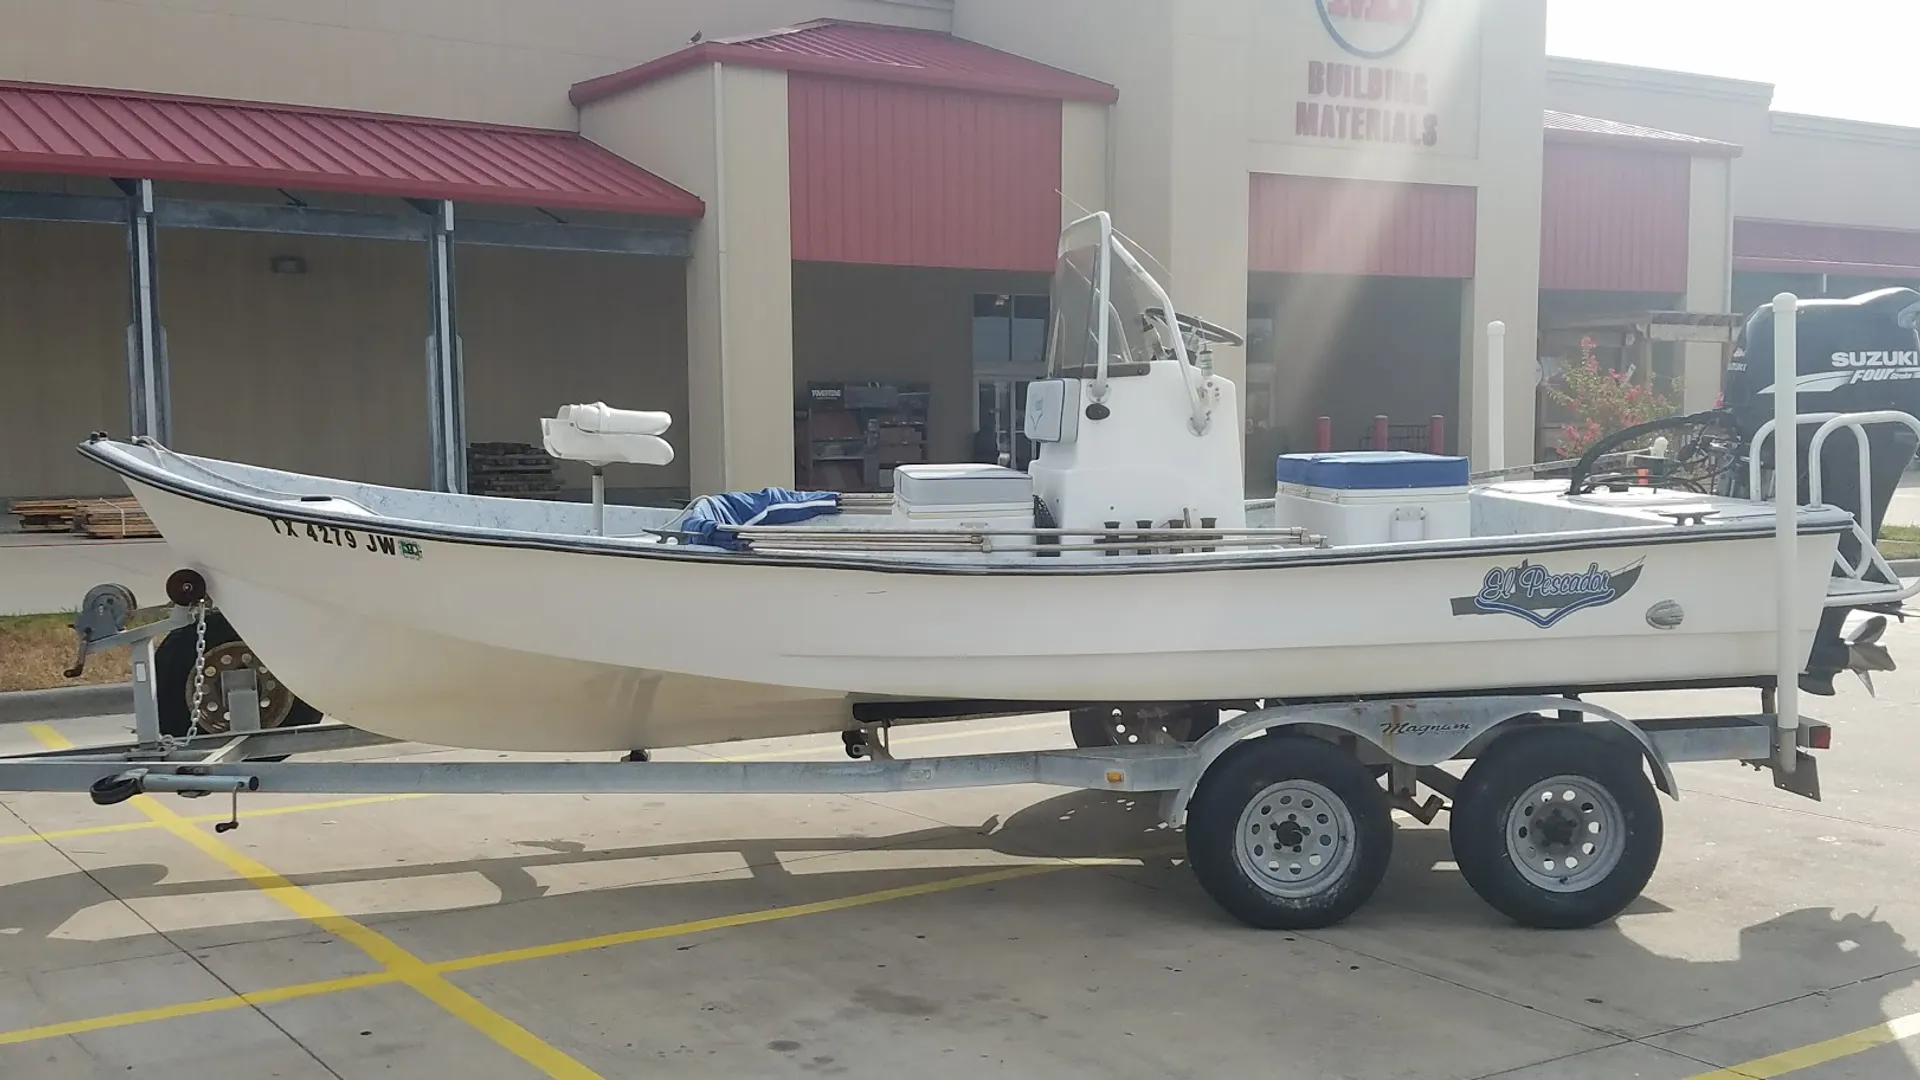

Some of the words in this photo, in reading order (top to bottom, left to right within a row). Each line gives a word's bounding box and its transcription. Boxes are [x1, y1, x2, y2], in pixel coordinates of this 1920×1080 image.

[1307, 60, 1428, 106] BUILDING
[1295, 101, 1438, 147] MATERIALS
[1831, 351, 1918, 367] SUZUKI
[267, 517, 299, 538] TX
[306, 523, 357, 549] 4279
[366, 534, 396, 556] JW
[1479, 566, 1517, 601] El
[1519, 562, 1611, 598] Pescador
[1380, 722, 1471, 736] Magnum
